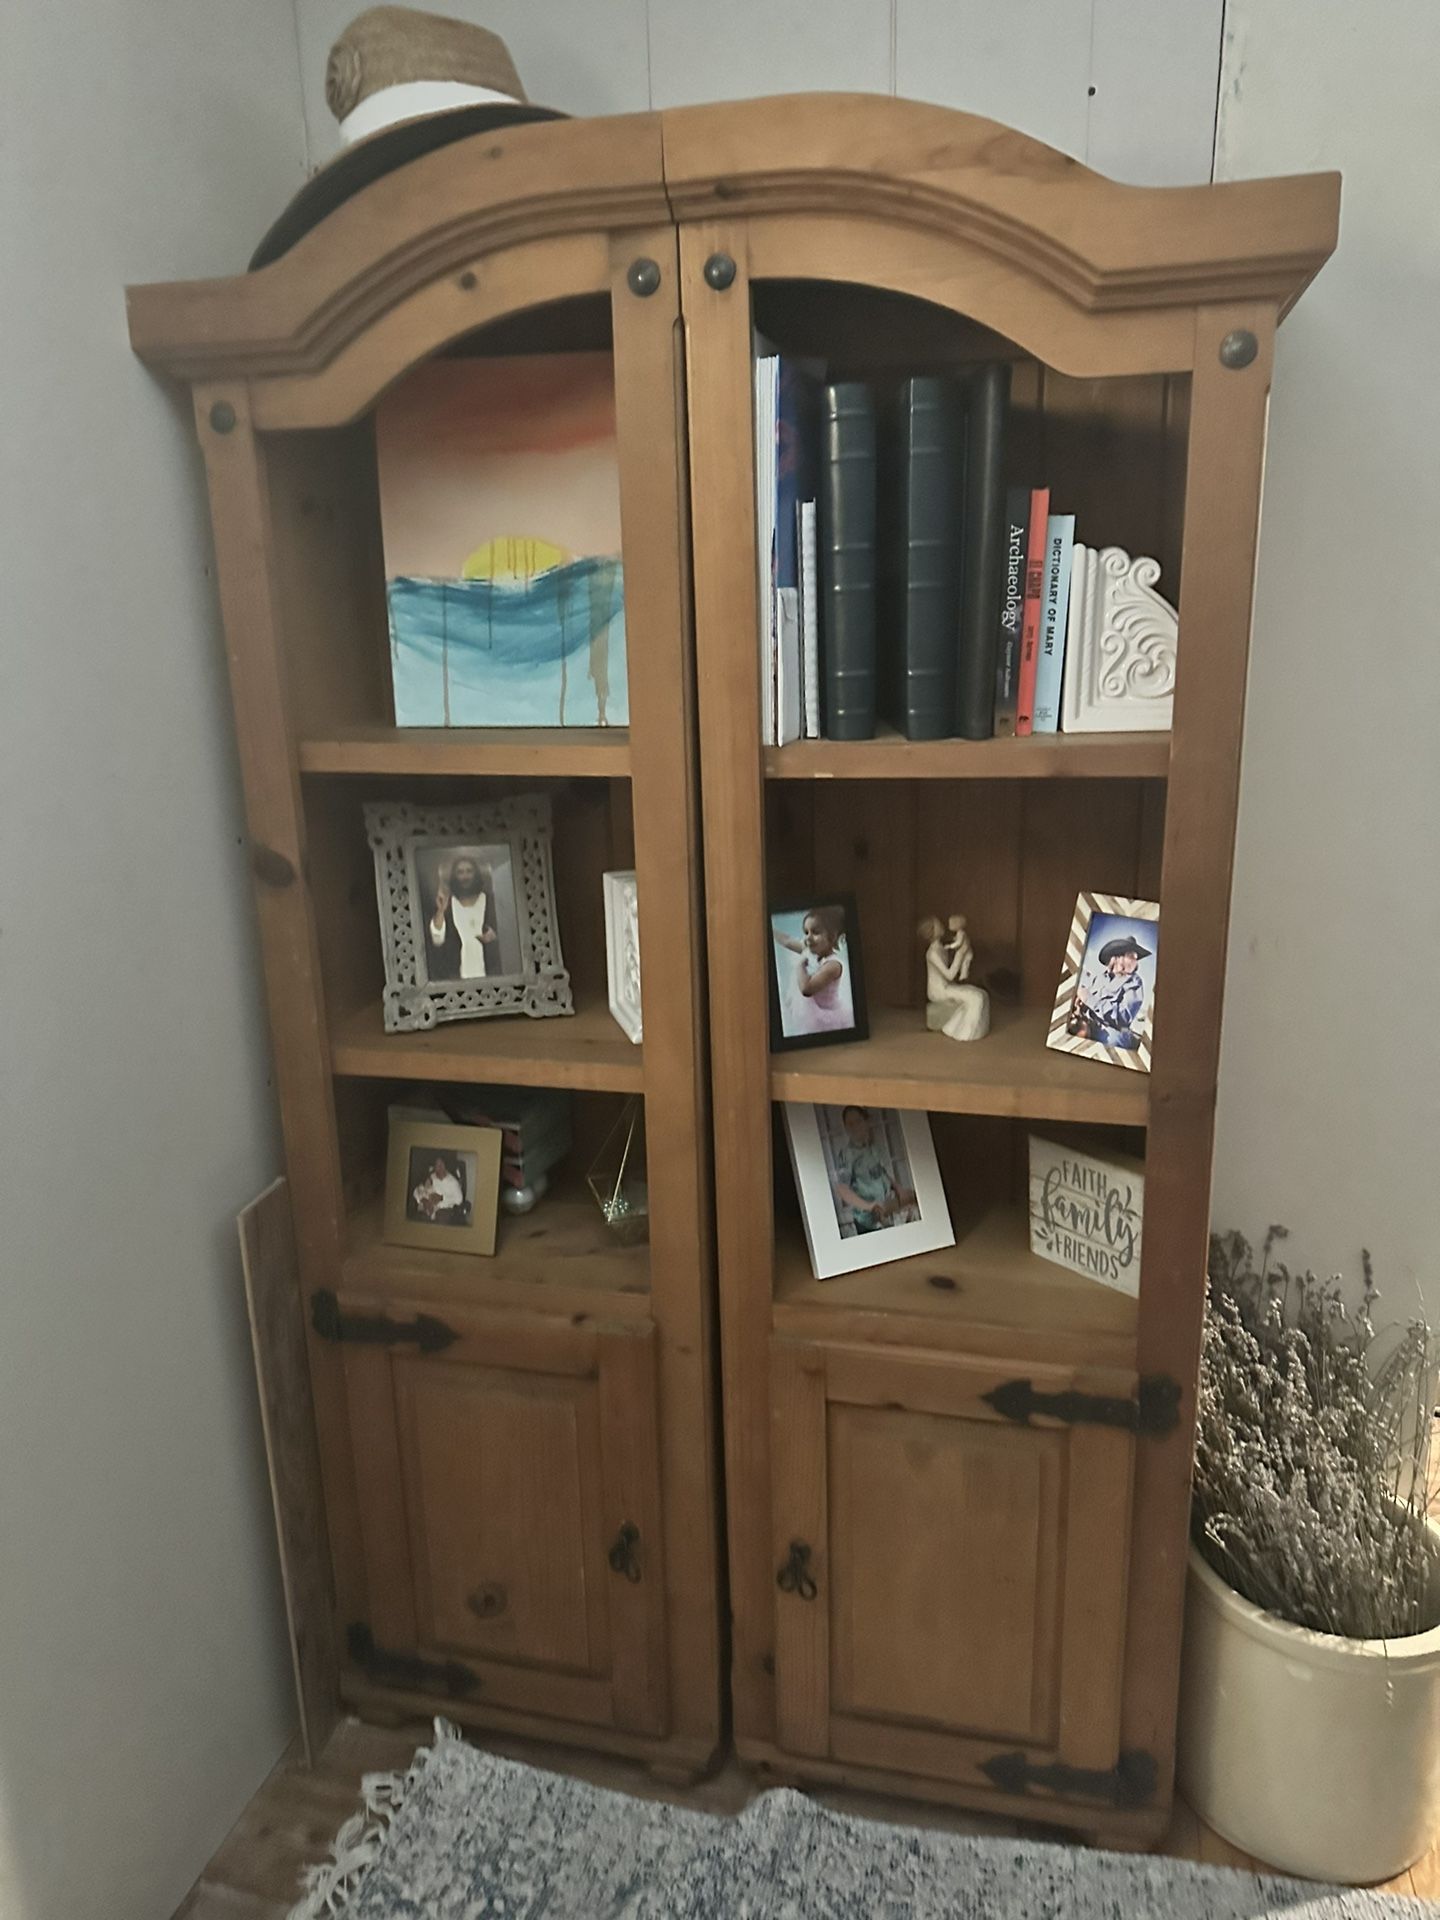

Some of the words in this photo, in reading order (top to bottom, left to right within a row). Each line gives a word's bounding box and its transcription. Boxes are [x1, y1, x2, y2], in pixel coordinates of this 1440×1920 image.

[1002, 524, 1025, 632] Archaeology
[1048, 538, 1063, 605] DICTIONARY
[1047, 608, 1057, 623] OF
[1044, 626, 1056, 656] MARY
[1062, 1159, 1108, 1198] FAITH
[1055, 1233, 1120, 1280] FRIENDS
